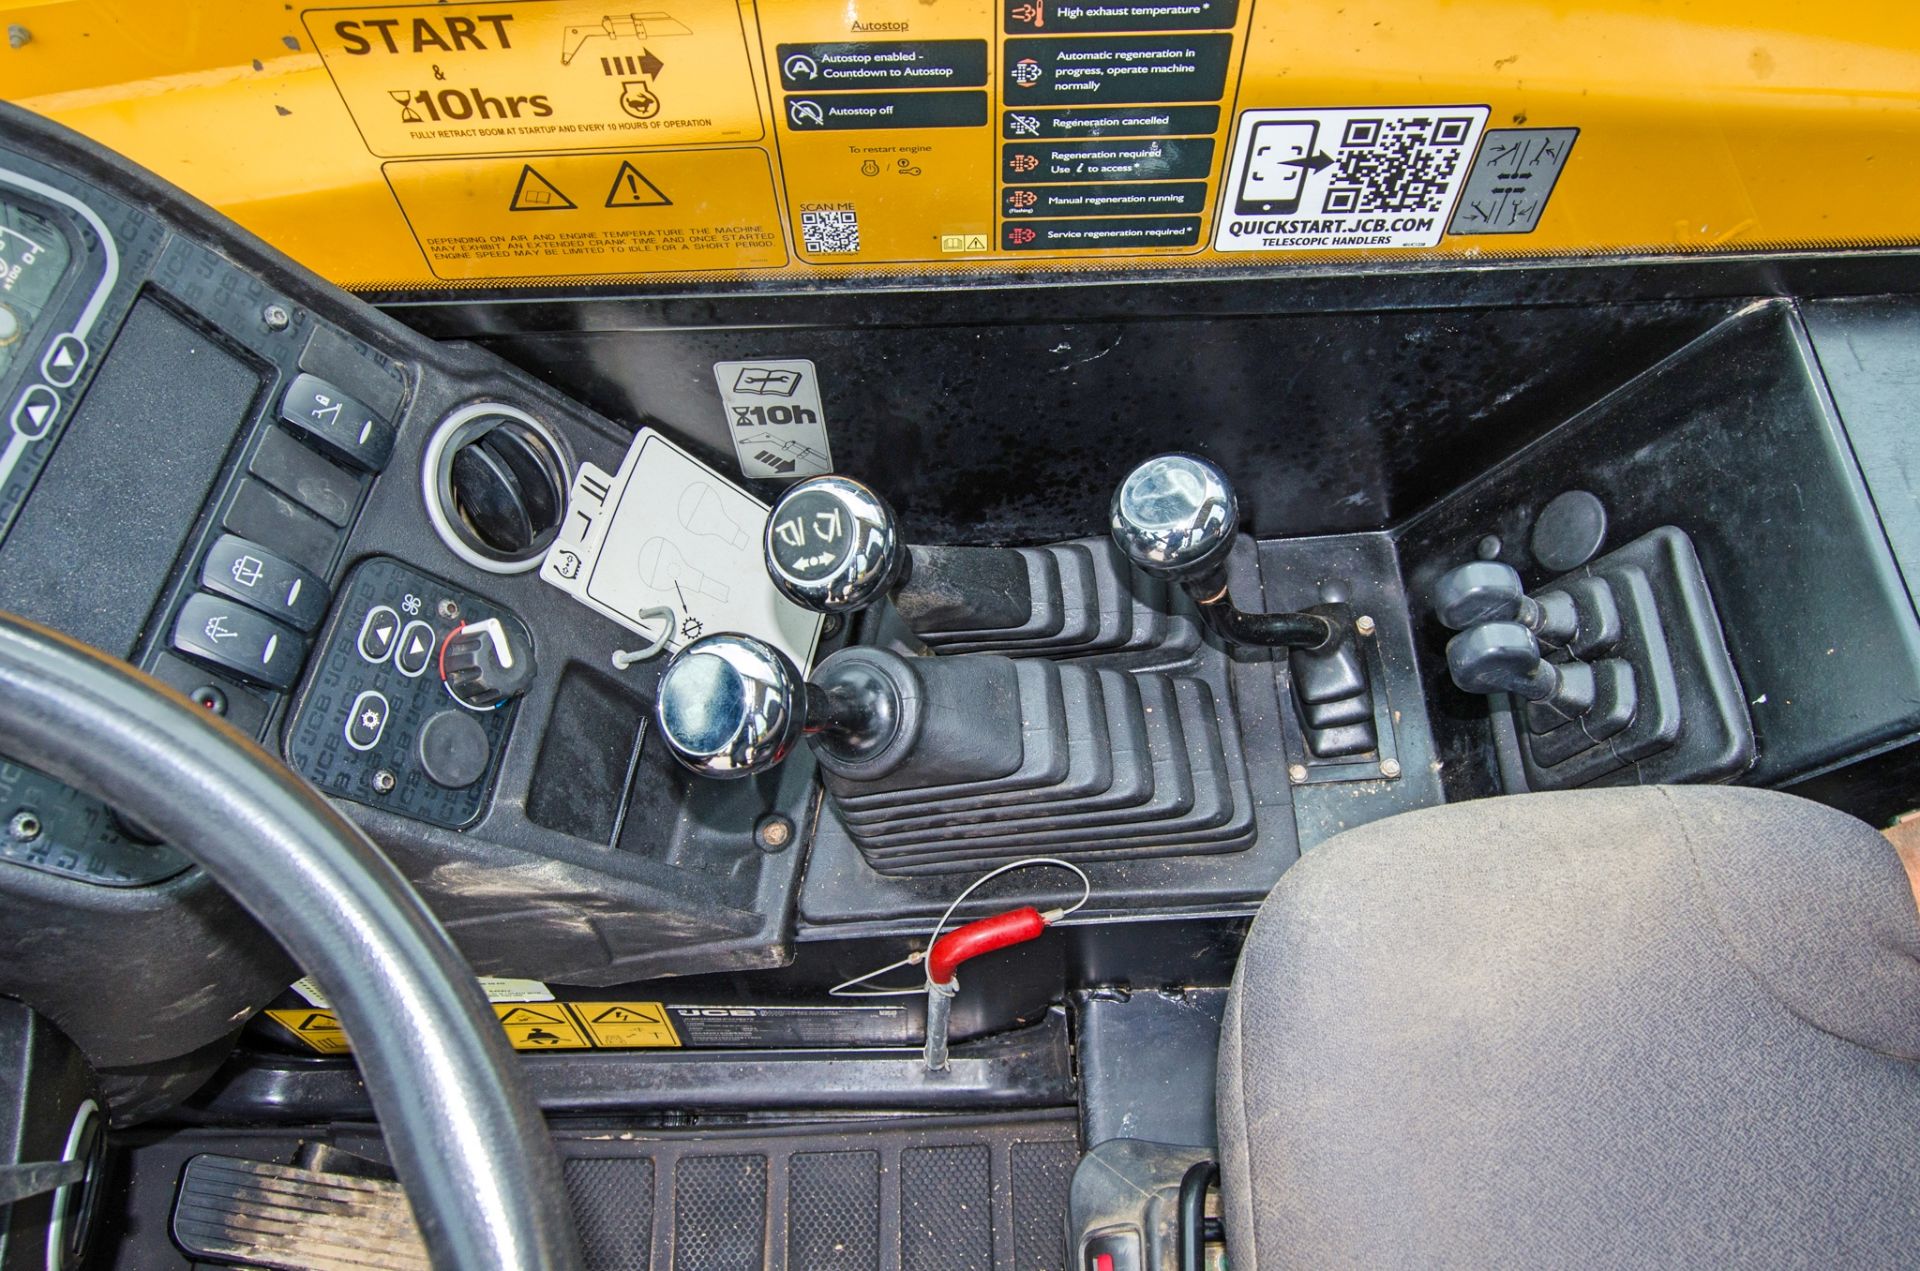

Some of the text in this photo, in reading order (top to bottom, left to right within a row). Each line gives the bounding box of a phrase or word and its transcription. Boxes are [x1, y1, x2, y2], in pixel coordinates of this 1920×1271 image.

[1057, 7, 1084, 19] High
[1086, 6, 1128, 16] exhaust
[852, 20, 909, 32] Autostop
[334, 14, 514, 55] START
[821, 54, 872, 64] Autostop
[874, 52, 916, 62] enabled
[1056, 49, 1196, 61] Automatic regeneration in
[432, 64, 446, 81] &
[824, 67, 953, 78] Countdown to Autostop
[1056, 64, 1196, 78] progress, operate machine
[1055, 81, 1100, 92] normally
[414, 88, 553, 122] 10hrs
[828, 106, 894, 117] Autostop off
[1053, 116, 1169, 129] Regeneration cancelled
[410, 119, 712, 140] FULLY RETRACT BOOM AT STARTUP AND EVERY 10 HOURS OF OPERATION
[849, 146, 861, 154] To
[899, 146, 932, 154] engine
[1052, 149, 1162, 161] Regeneration required
[1051, 166, 1070, 174] Use
[1048, 194, 1184, 206] Manual regeneration running
[800, 202, 855, 212] SCAN ME
[1229, 218, 1434, 237] QUICKSTART.JCB.COM
[426, 236, 486, 245] DEPENDING
[532, 233, 556, 241] AND
[560, 232, 596, 240] ENGINE
[603, 229, 684, 238] TEMPERATURE
[714, 226, 762, 234] MACHINE
[1048, 230, 1082, 238] Service
[1084, 229, 1144, 239] regeneration
[460, 243, 501, 251] EXHIBIT
[528, 240, 584, 248] EXTENDED
[588, 238, 626, 247] CRANK
[722, 232, 776, 241] STARTED
[1262, 236, 1392, 247] TELESCOPIC HANDLERS
[434, 252, 472, 260] ENGINE
[476, 251, 510, 259] SPEED
[562, 247, 605, 255] LIMITED
[694, 242, 730, 250] SHORT
[750, 405, 817, 426] 10h
